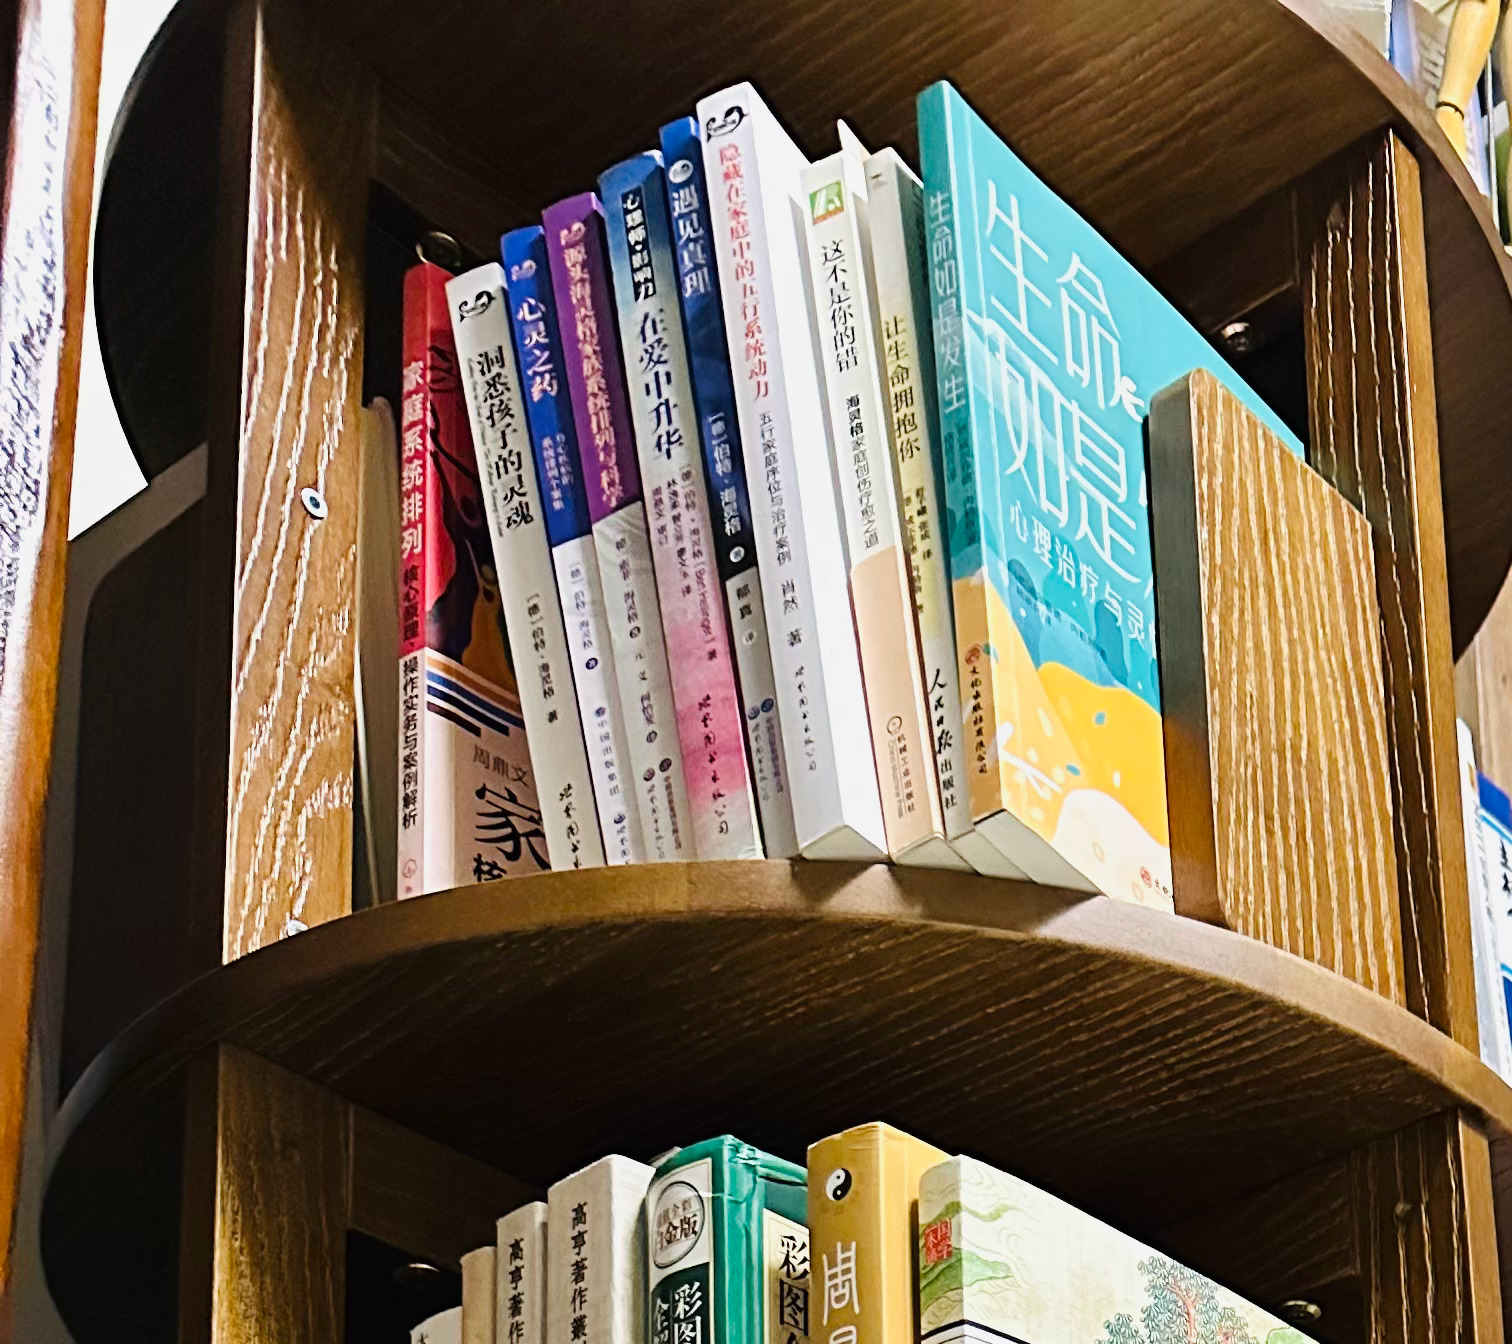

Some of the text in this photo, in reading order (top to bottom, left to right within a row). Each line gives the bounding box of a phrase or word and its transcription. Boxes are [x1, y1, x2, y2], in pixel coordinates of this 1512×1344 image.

[672, 185, 711, 298] 遇见真理
[719, 143, 769, 401] 隐藏在家庭中的五行系统动力
[822, 240, 859, 374] 这不是你的错
[986, 179, 1144, 423] 生命
[517, 297, 558, 402] 心灵之药
[639, 309, 685, 460] 在爱中升华
[884, 316, 920, 463] 让生命拥抱你
[401, 360, 424, 559] 家庭系统排列
[477, 345, 534, 530] 洞悉孩子的灵魂
[759, 412, 791, 567] 五行家庭序位与治疗案例
[929, 668, 958, 810] 人民日报出版社
